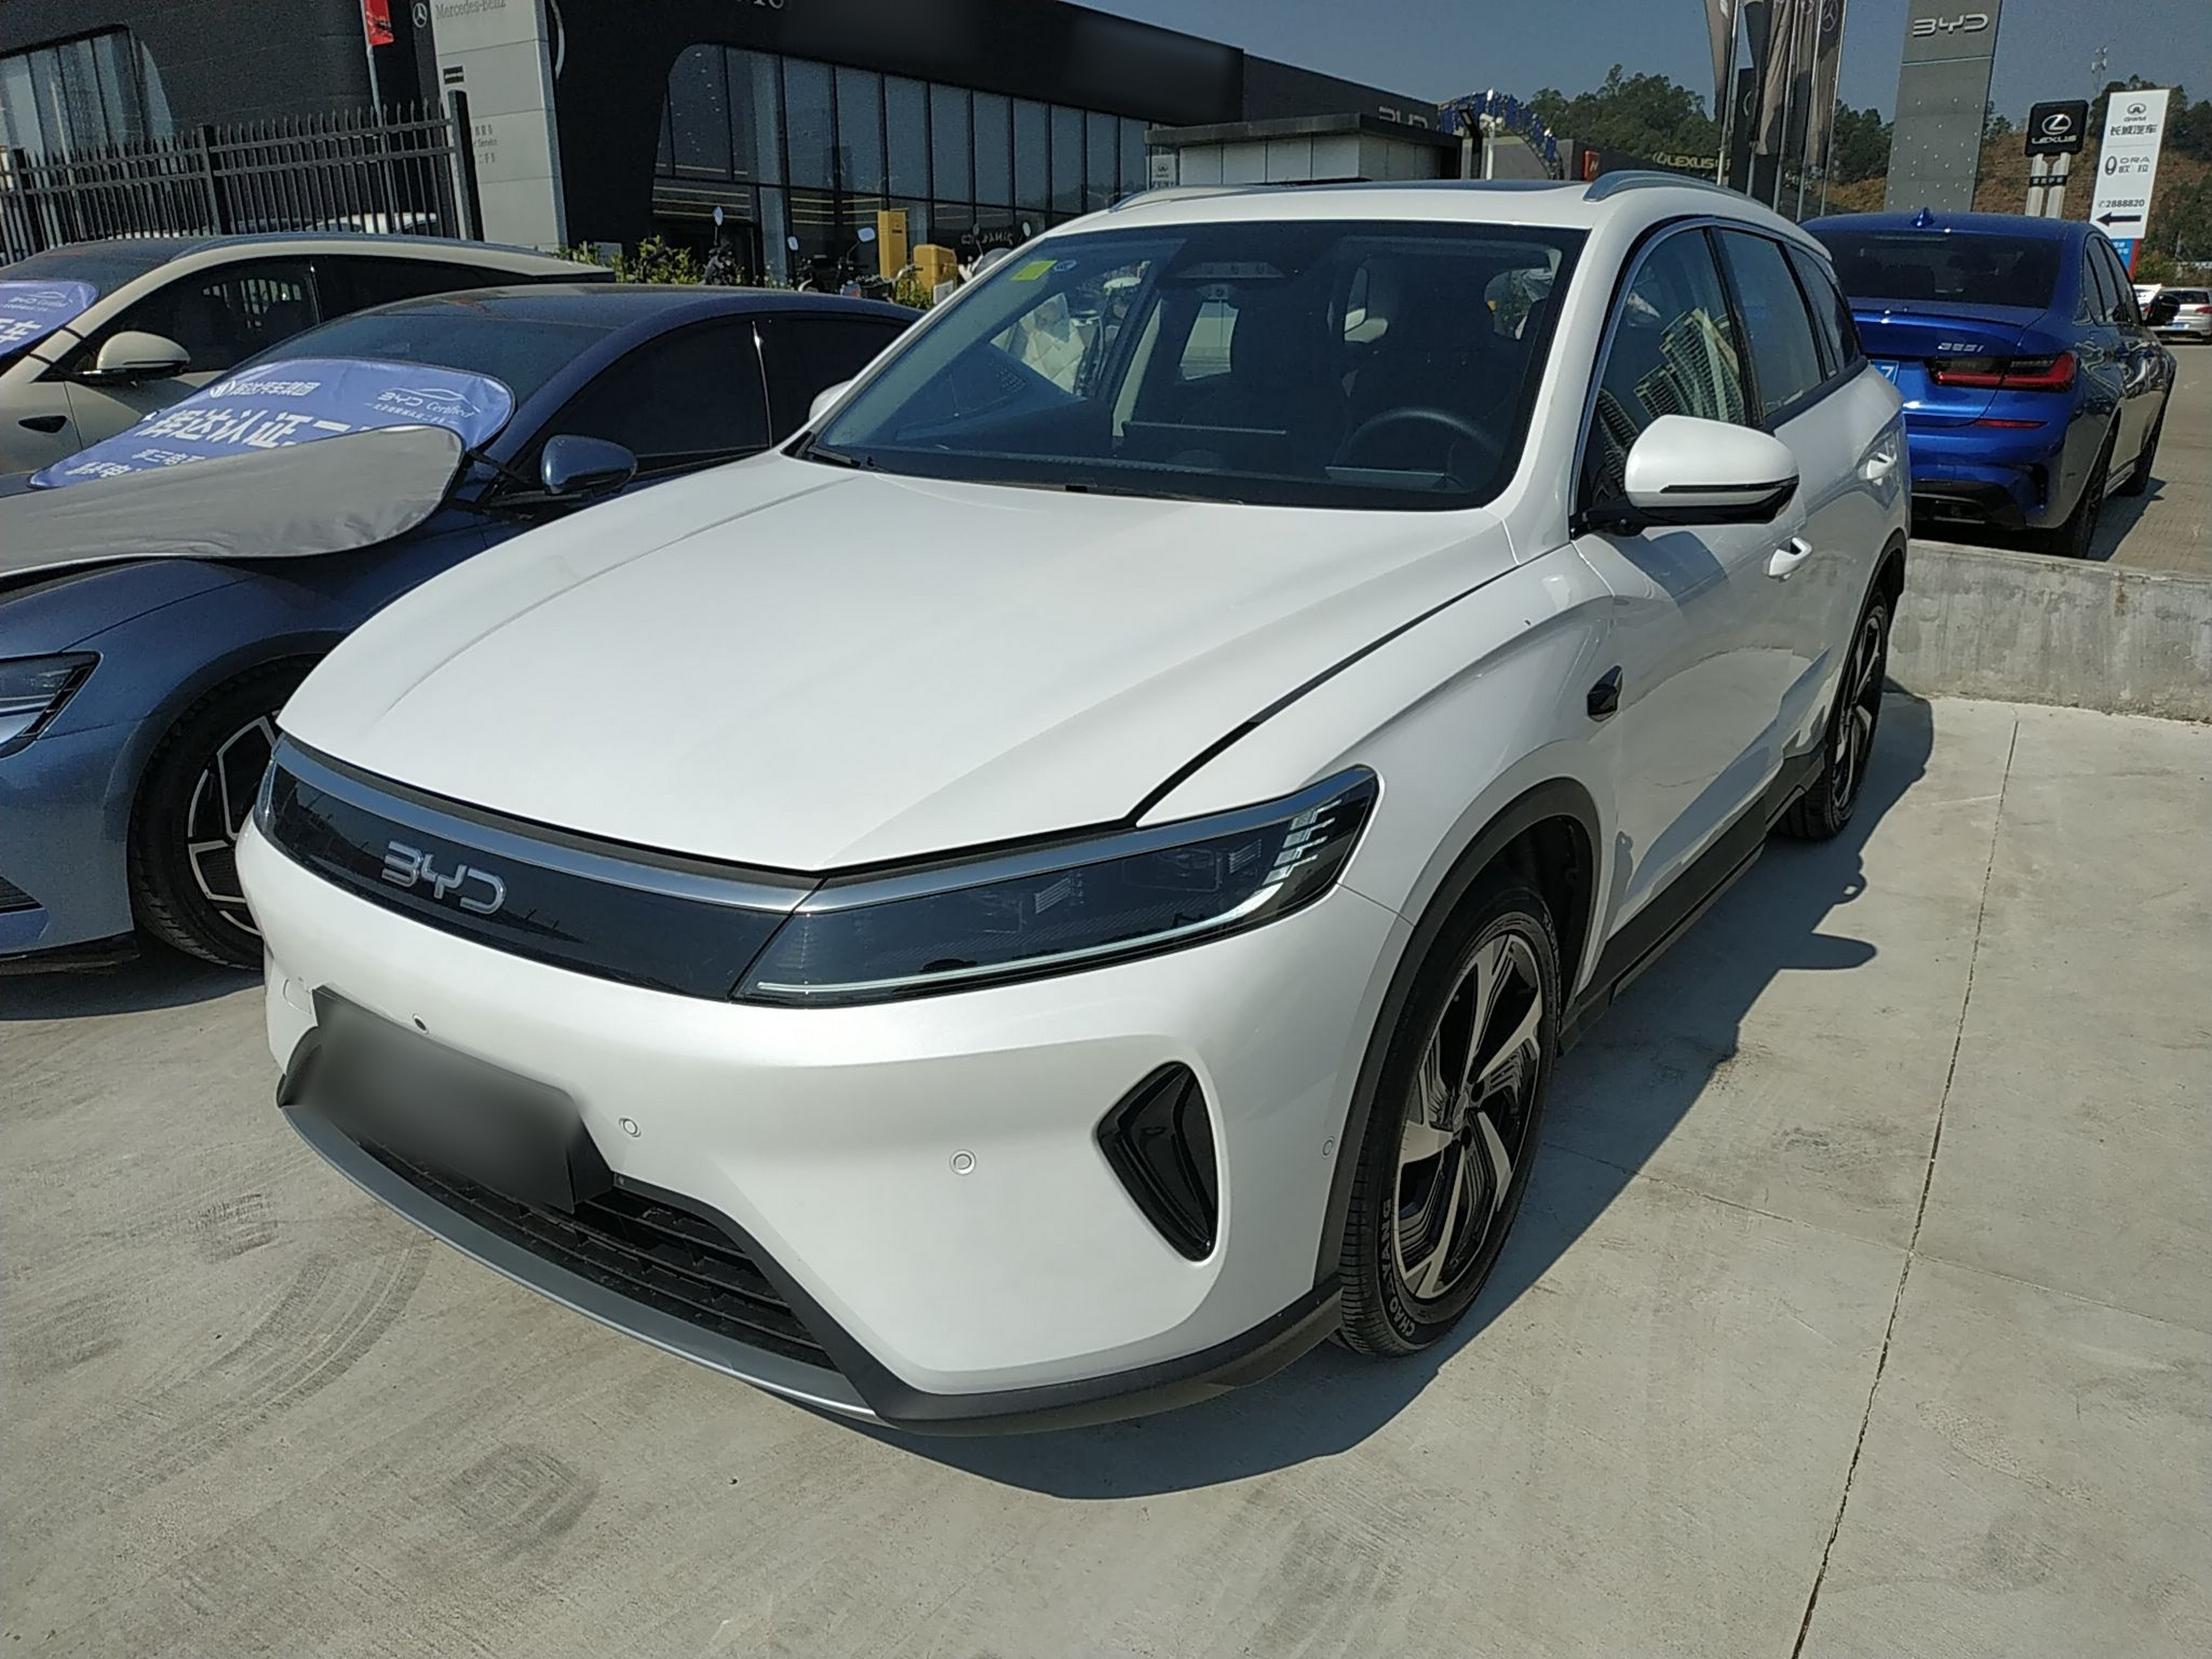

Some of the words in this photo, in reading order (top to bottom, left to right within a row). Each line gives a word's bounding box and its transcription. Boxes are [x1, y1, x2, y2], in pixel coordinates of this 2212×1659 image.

[1912, 13, 1989, 37] BYD
[2110, 124, 2158, 136] 长城汽车
[2031, 135, 2077, 144] LEXUS
[1667, 154, 1715, 169] LEXUS
[2119, 156, 2150, 164] ORA
[2105, 199, 2145, 208] 2888820
[377, 391, 423, 407] BYD
[381, 840, 507, 915] BYD
